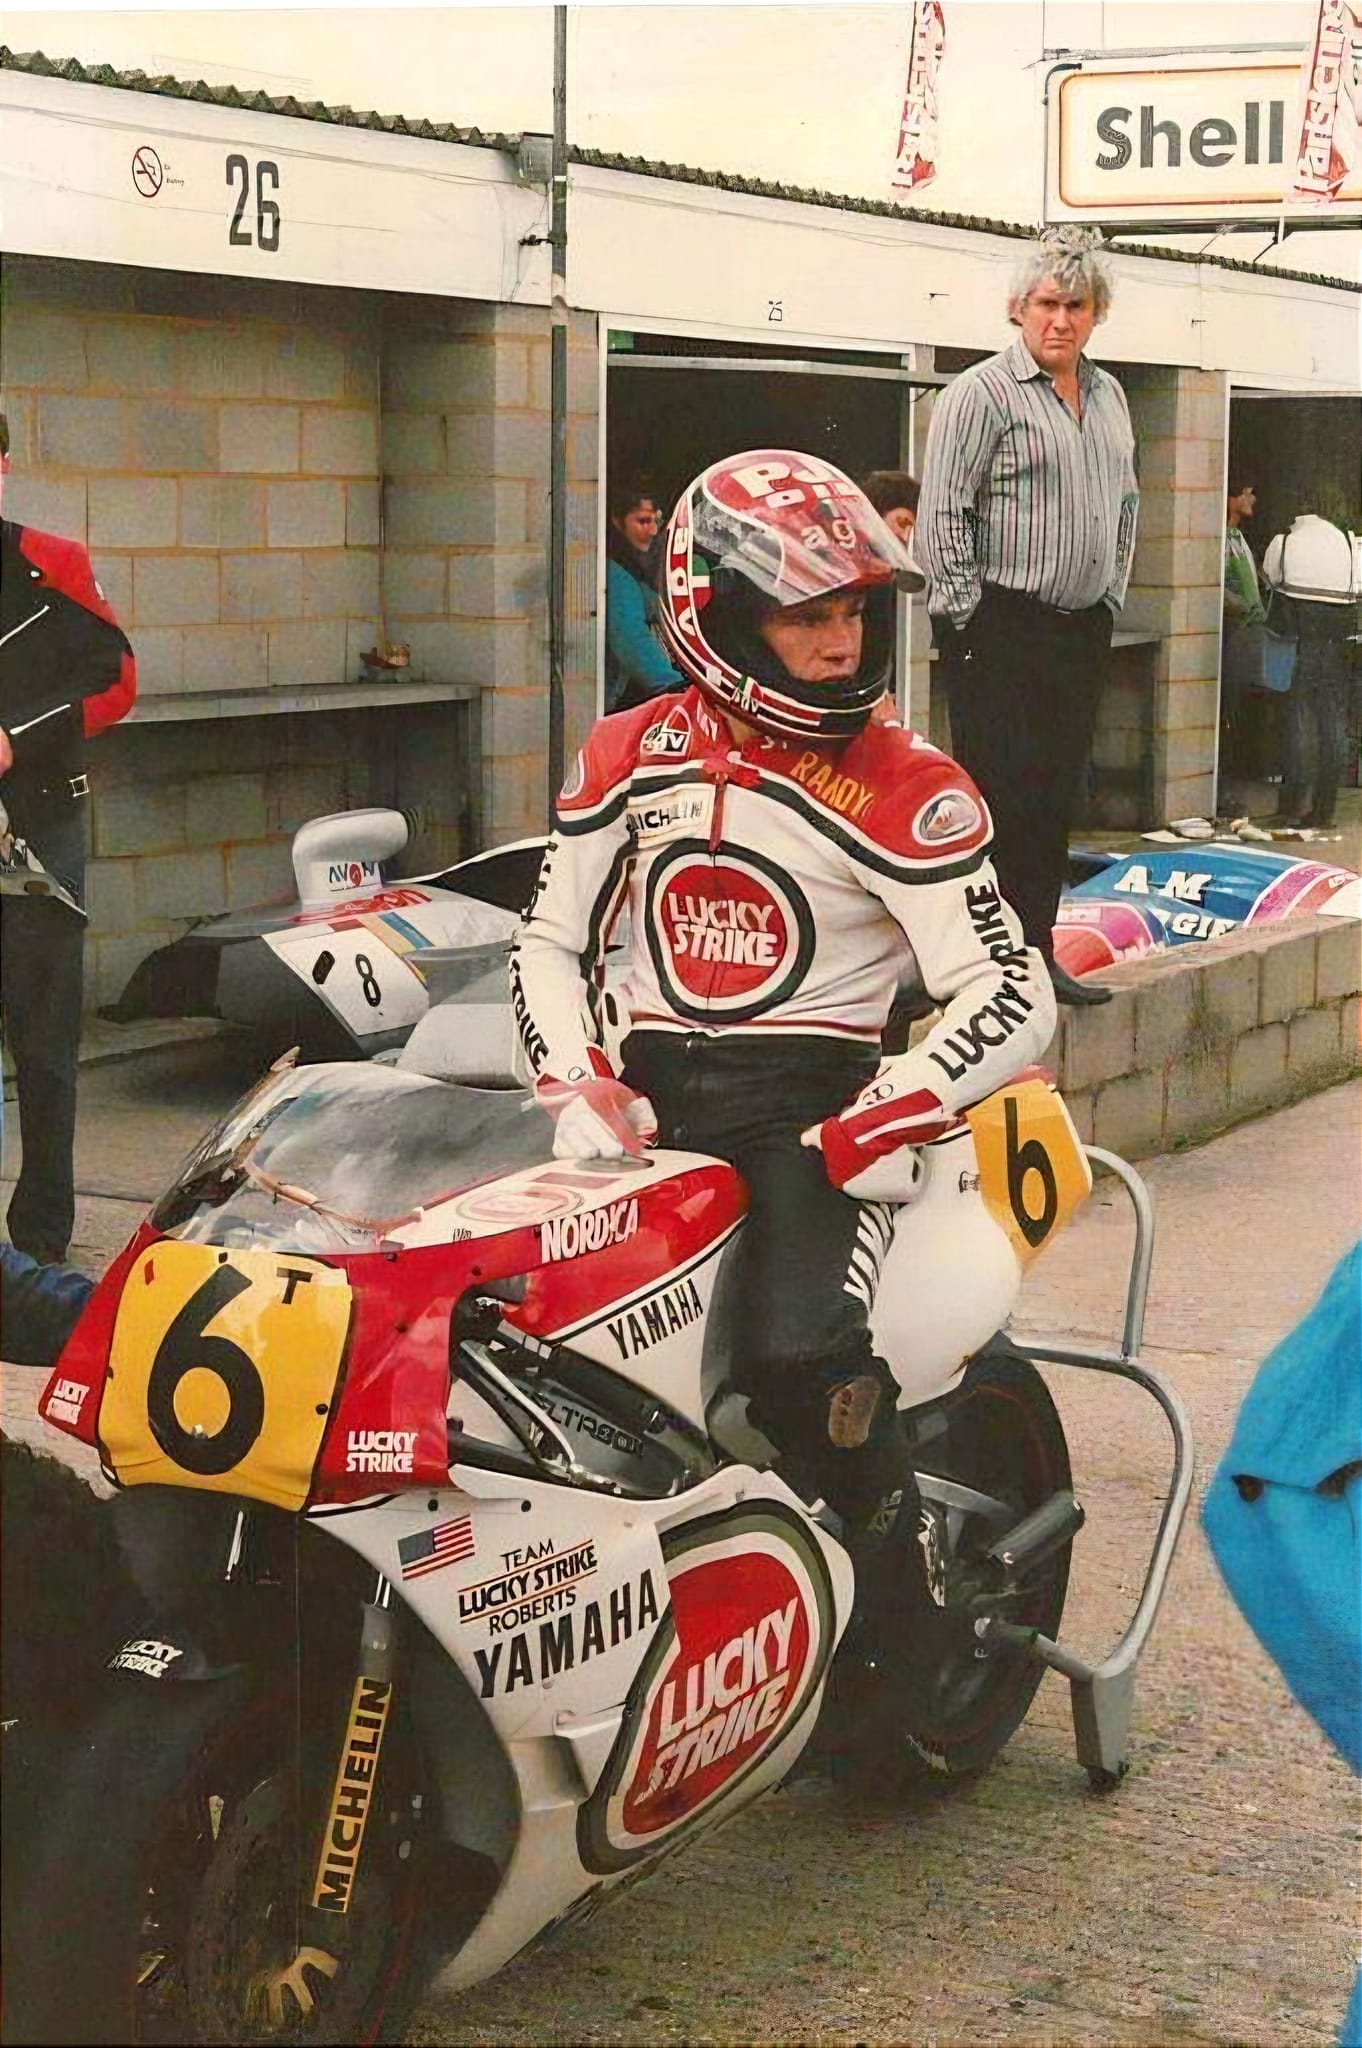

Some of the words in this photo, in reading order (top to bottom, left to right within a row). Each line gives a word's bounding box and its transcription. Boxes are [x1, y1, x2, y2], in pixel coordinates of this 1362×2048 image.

[1095, 101, 1285, 170] Shell
[226, 154, 281, 252] 26
[668, 892, 775, 932] LUCKY
[673, 923, 778, 967] STRIKE
[1004, 1097, 1058, 1248] 6
[607, 1278, 703, 1360] YAMAHA
[147, 1264, 265, 1476] 6
[276, 1267, 313, 1305] T
[346, 1453, 414, 1472] STRIKE
[348, 1431, 419, 1452] LUCKY
[459, 1572, 530, 1617] LUCKY
[534, 1545, 597, 1590] STRIKE
[501, 1538, 554, 1572] TEAM
[473, 1568, 659, 1698] YAMAHA
[489, 1586, 576, 1636] ROBERTS
[657, 1597, 798, 1749] LUCKY
[636, 1669, 790, 1806] STRIKE
[318, 1679, 390, 1911] MICHELIN
